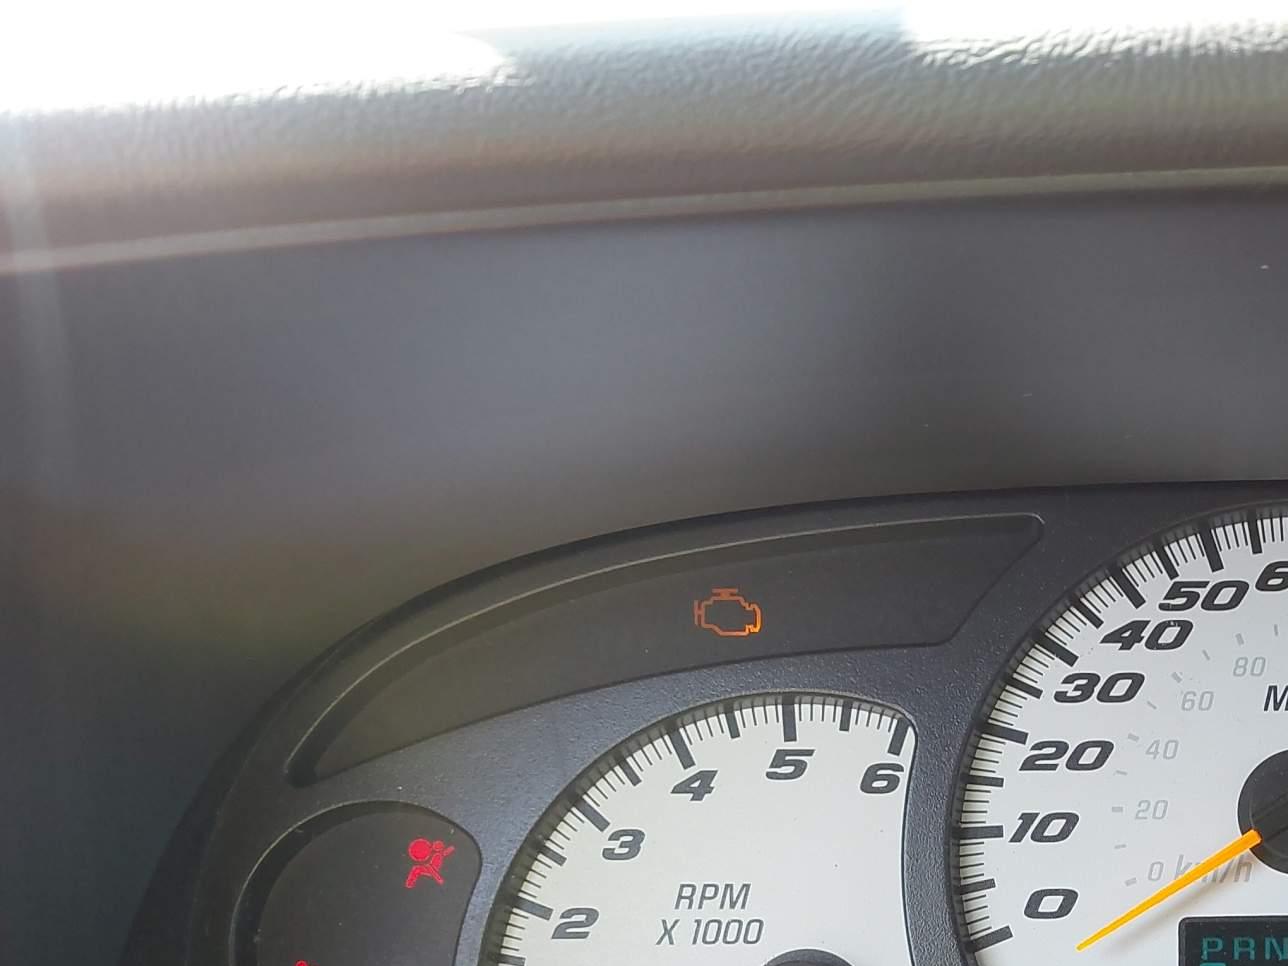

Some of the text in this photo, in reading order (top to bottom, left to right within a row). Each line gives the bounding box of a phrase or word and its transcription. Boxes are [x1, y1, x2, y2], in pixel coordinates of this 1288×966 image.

[1159, 579, 1249, 611] 50
[1098, 618, 1193, 650] 40
[1233, 657, 1266, 676] 80
[1054, 673, 1145, 703] 30
[1181, 691, 1214, 711] 60
[766, 749, 814, 780] 5
[1019, 738, 1114, 771] 20
[1146, 740, 1178, 759] 40
[672, 768, 717, 801] 4
[860, 763, 903, 794] 6
[1135, 800, 1168, 819] 20
[1010, 812, 1079, 842] 10
[601, 828, 645, 860] 3
[1148, 862, 1163, 881] 0
[675, 884, 750, 909] RPM
[1024, 889, 1078, 919] 0
[551, 908, 599, 939] 2
[656, 919, 763, 945] X 1000
